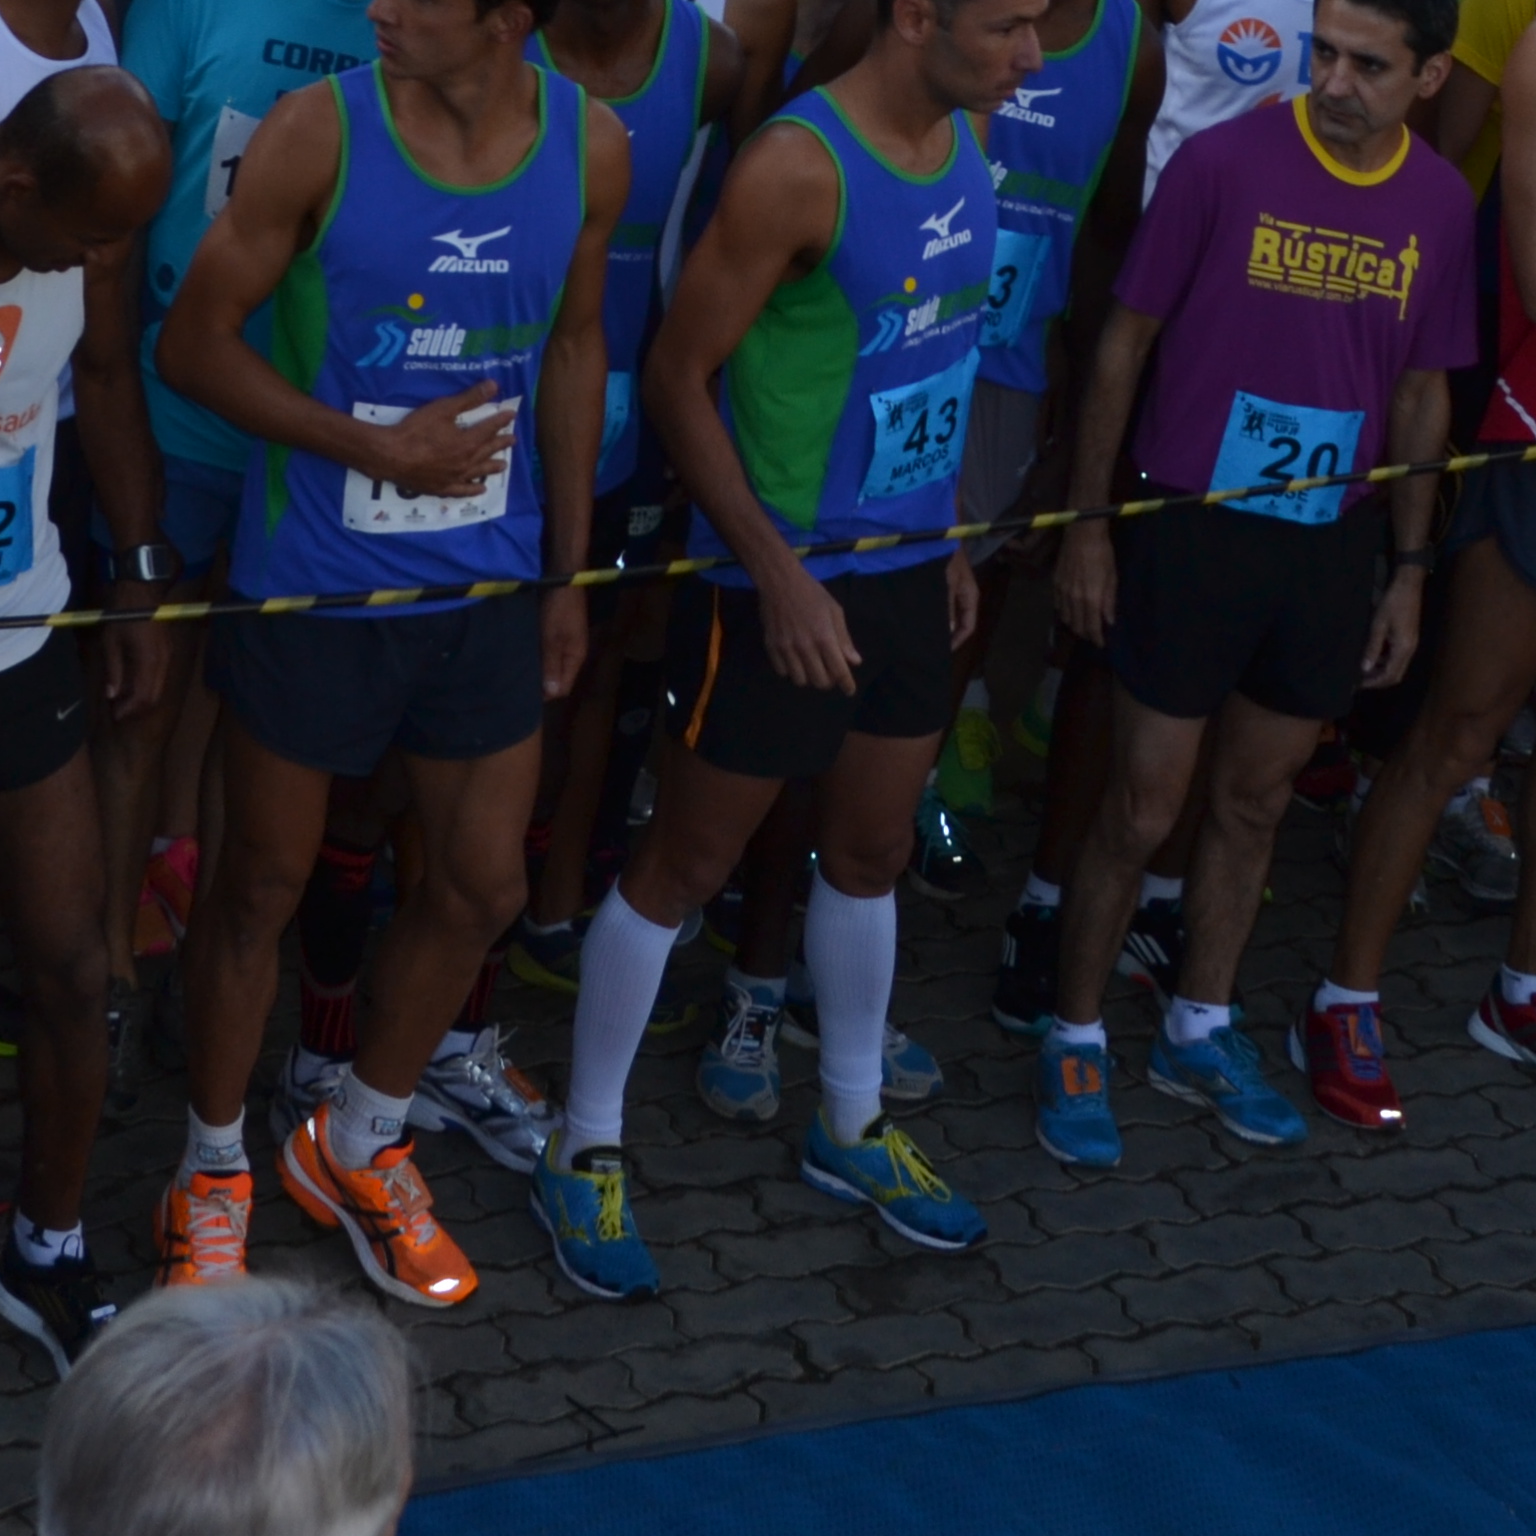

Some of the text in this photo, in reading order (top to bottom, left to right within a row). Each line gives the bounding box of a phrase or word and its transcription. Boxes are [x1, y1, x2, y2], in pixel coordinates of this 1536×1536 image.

[262, 38, 372, 76] CORP
[406, 322, 468, 357] saúde
[902, 396, 959, 456] 43
[889, 443, 943, 481] MARCOS
